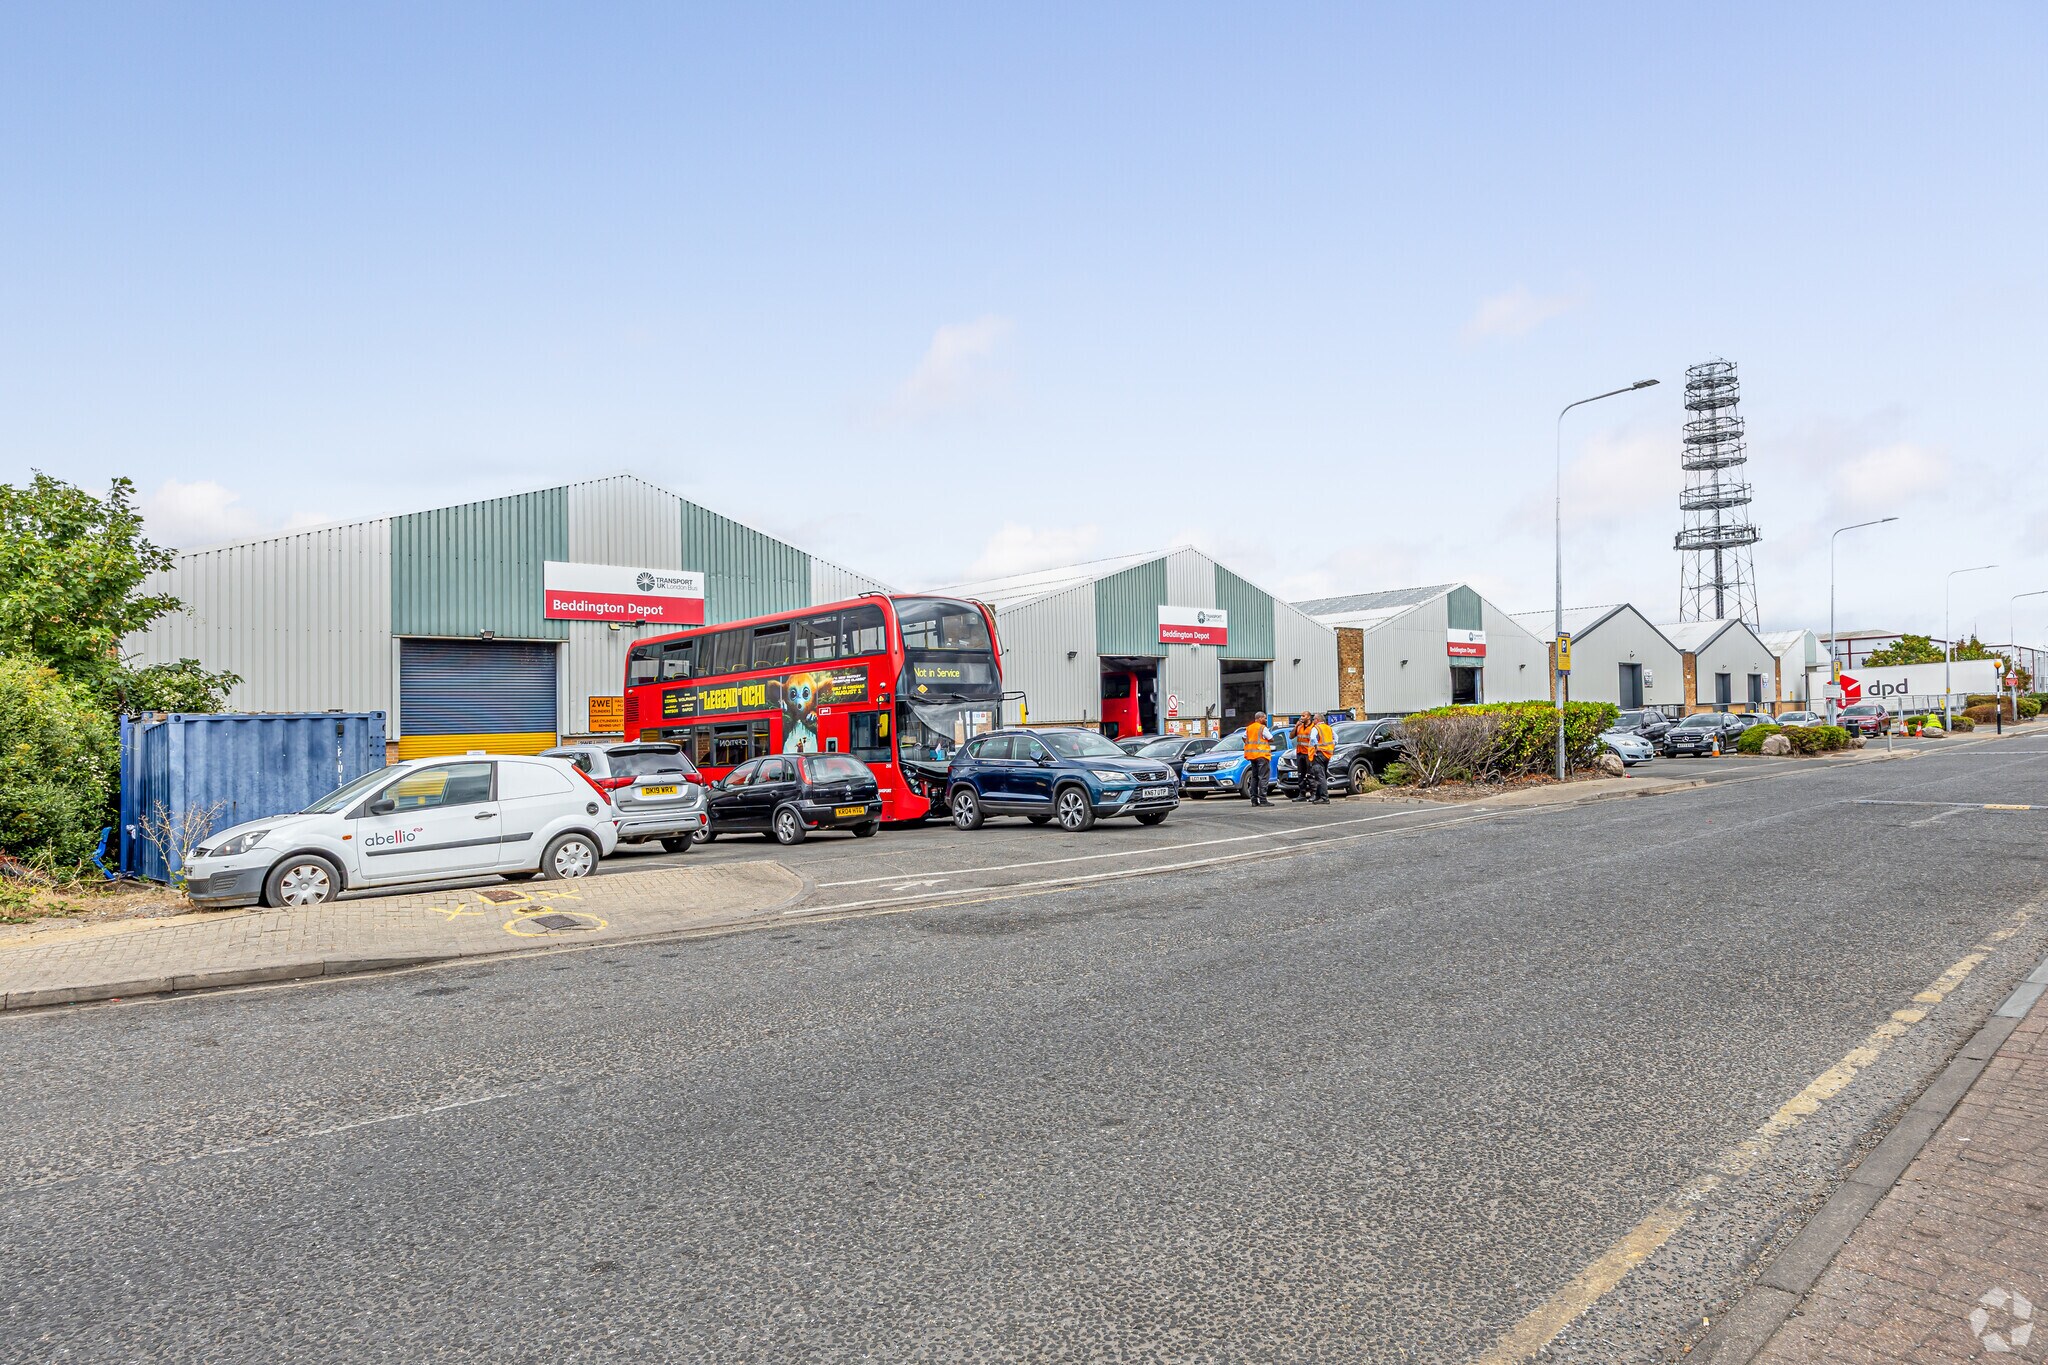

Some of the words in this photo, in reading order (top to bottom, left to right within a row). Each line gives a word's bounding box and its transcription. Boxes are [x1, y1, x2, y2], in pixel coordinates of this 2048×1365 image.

[656, 577, 693, 585] TRANSPORT
[553, 600, 624, 614] Beddington
[628, 604, 664, 616] Depot
[1162, 630, 1193, 640] Beddington
[1194, 632, 1210, 640] Depot
[914, 668, 926, 678] Not
[929, 669, 935, 677] in
[936, 668, 960, 678] Service
[1868, 678, 1908, 699] dpd
[704, 688, 738, 710] LEGEND
[742, 684, 765, 707] OCHI
[365, 830, 416, 846] abellio
